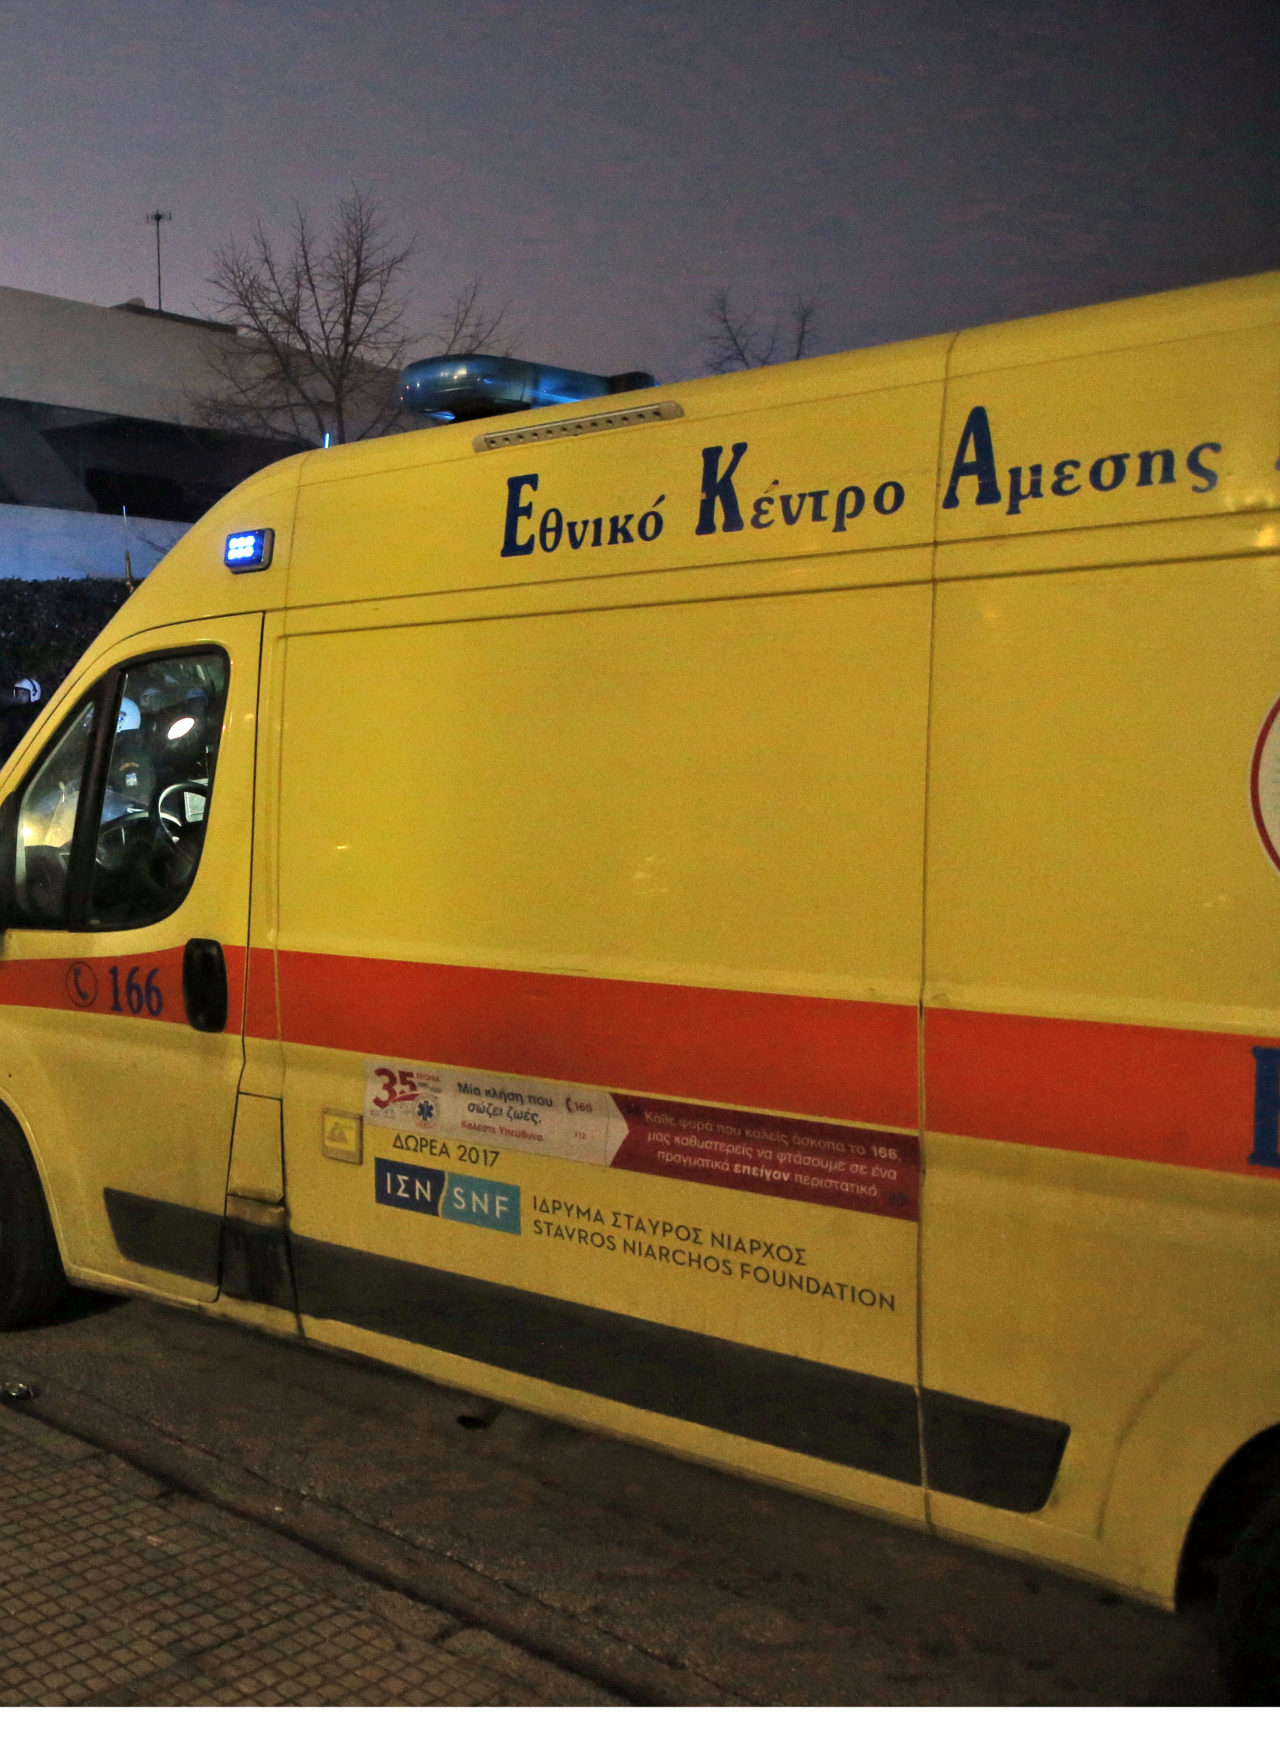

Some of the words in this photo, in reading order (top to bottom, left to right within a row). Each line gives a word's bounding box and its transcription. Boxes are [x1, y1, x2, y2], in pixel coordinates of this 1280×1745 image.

[501, 473, 665, 557] Εθνικό
[695, 442, 905, 535] Κέντρο
[942, 405, 1222, 515] Αμεσης
[108, 965, 163, 1016] 166
[373, 1068, 418, 1109] 35
[457, 1082, 481, 1096] Μία
[485, 1087, 524, 1105] κλήση
[528, 1095, 553, 1107] που
[467, 1101, 503, 1118] σώζει
[393, 1133, 450, 1158] ΔΩΡΕΑ
[457, 1144, 500, 1168] 2017
[647, 1131, 671, 1146] μας
[757, 1148, 772, 1160] να
[849, 1163, 867, 1175] σε
[871, 1164, 897, 1181] ένα
[716, 1124, 740, 1136] που
[848, 1143, 866, 1156] το
[386, 1172, 431, 1203] ΙΣΝ
[733, 1163, 791, 1182] επείγον
[453, 1186, 509, 1219] SNF
[533, 1195, 605, 1225] ΙΔΡΥΜΑ
[611, 1212, 703, 1246] ΣΤΑΥΡΟΣ
[710, 1232, 807, 1266] ΝΙΑΡΧΟΣ
[534, 1221, 616, 1251] STAVROS
[623, 1240, 732, 1276] NIARCHOS
[740, 1263, 896, 1311] FOUNDATION
